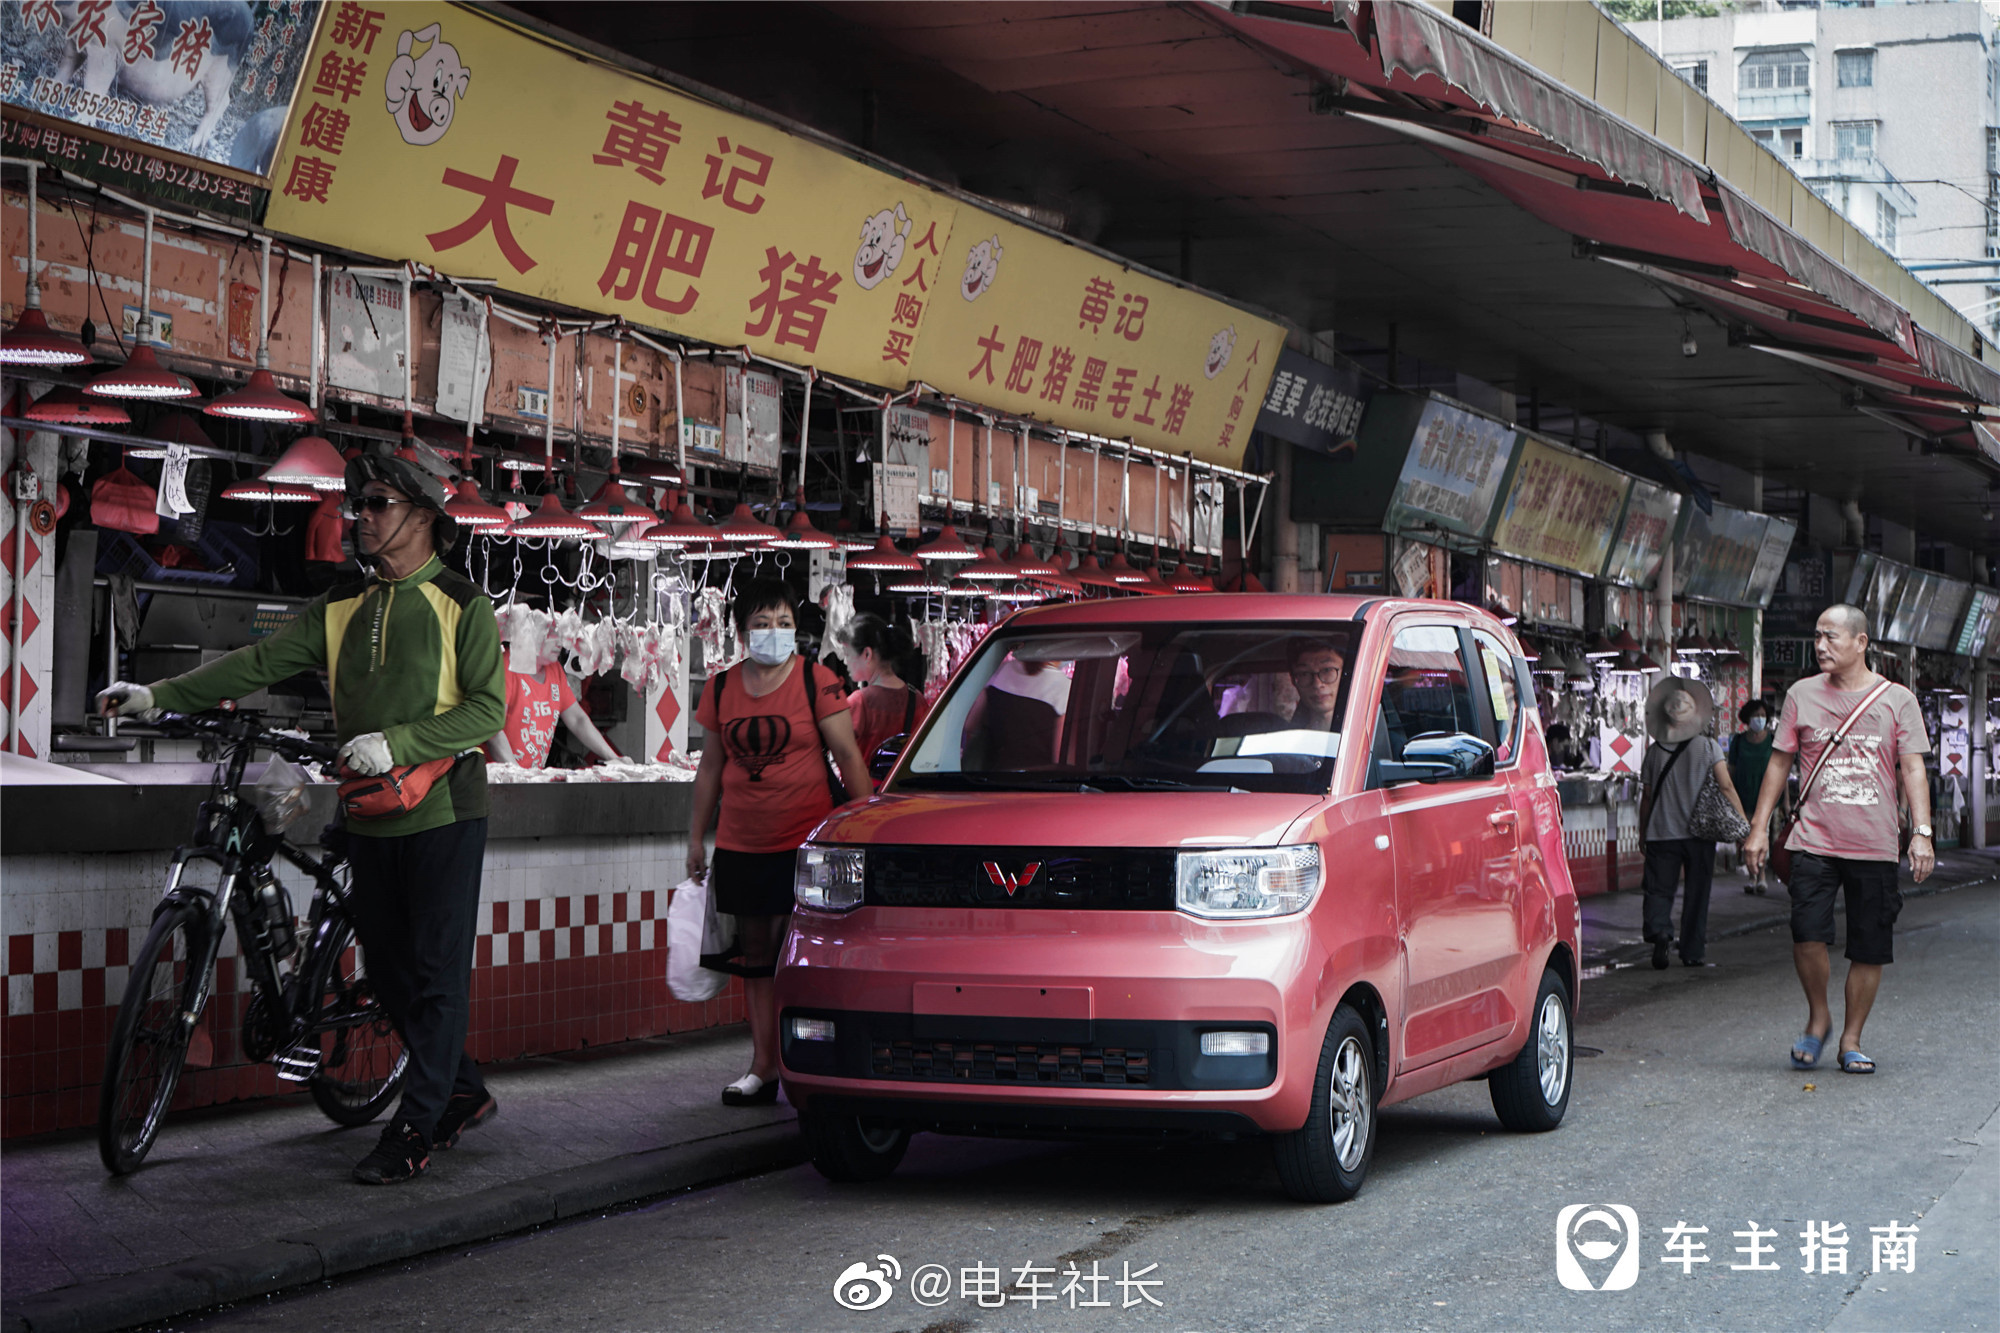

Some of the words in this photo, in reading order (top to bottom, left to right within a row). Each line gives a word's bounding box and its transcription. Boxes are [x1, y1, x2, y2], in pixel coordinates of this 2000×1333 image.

[283, 2, 385, 205] 新鲜健康
[592, 100, 774, 214] 黄记
[425, 154, 843, 354] 大肥猪
[882, 221, 939, 366] 人人购买
[1079, 276, 1149, 342] 黄记
[968, 325, 1194, 436] 大肥猪黑毛土猪
[1217, 339, 1260, 449] 人人购买
[1262, 371, 1307, 418] 重要
